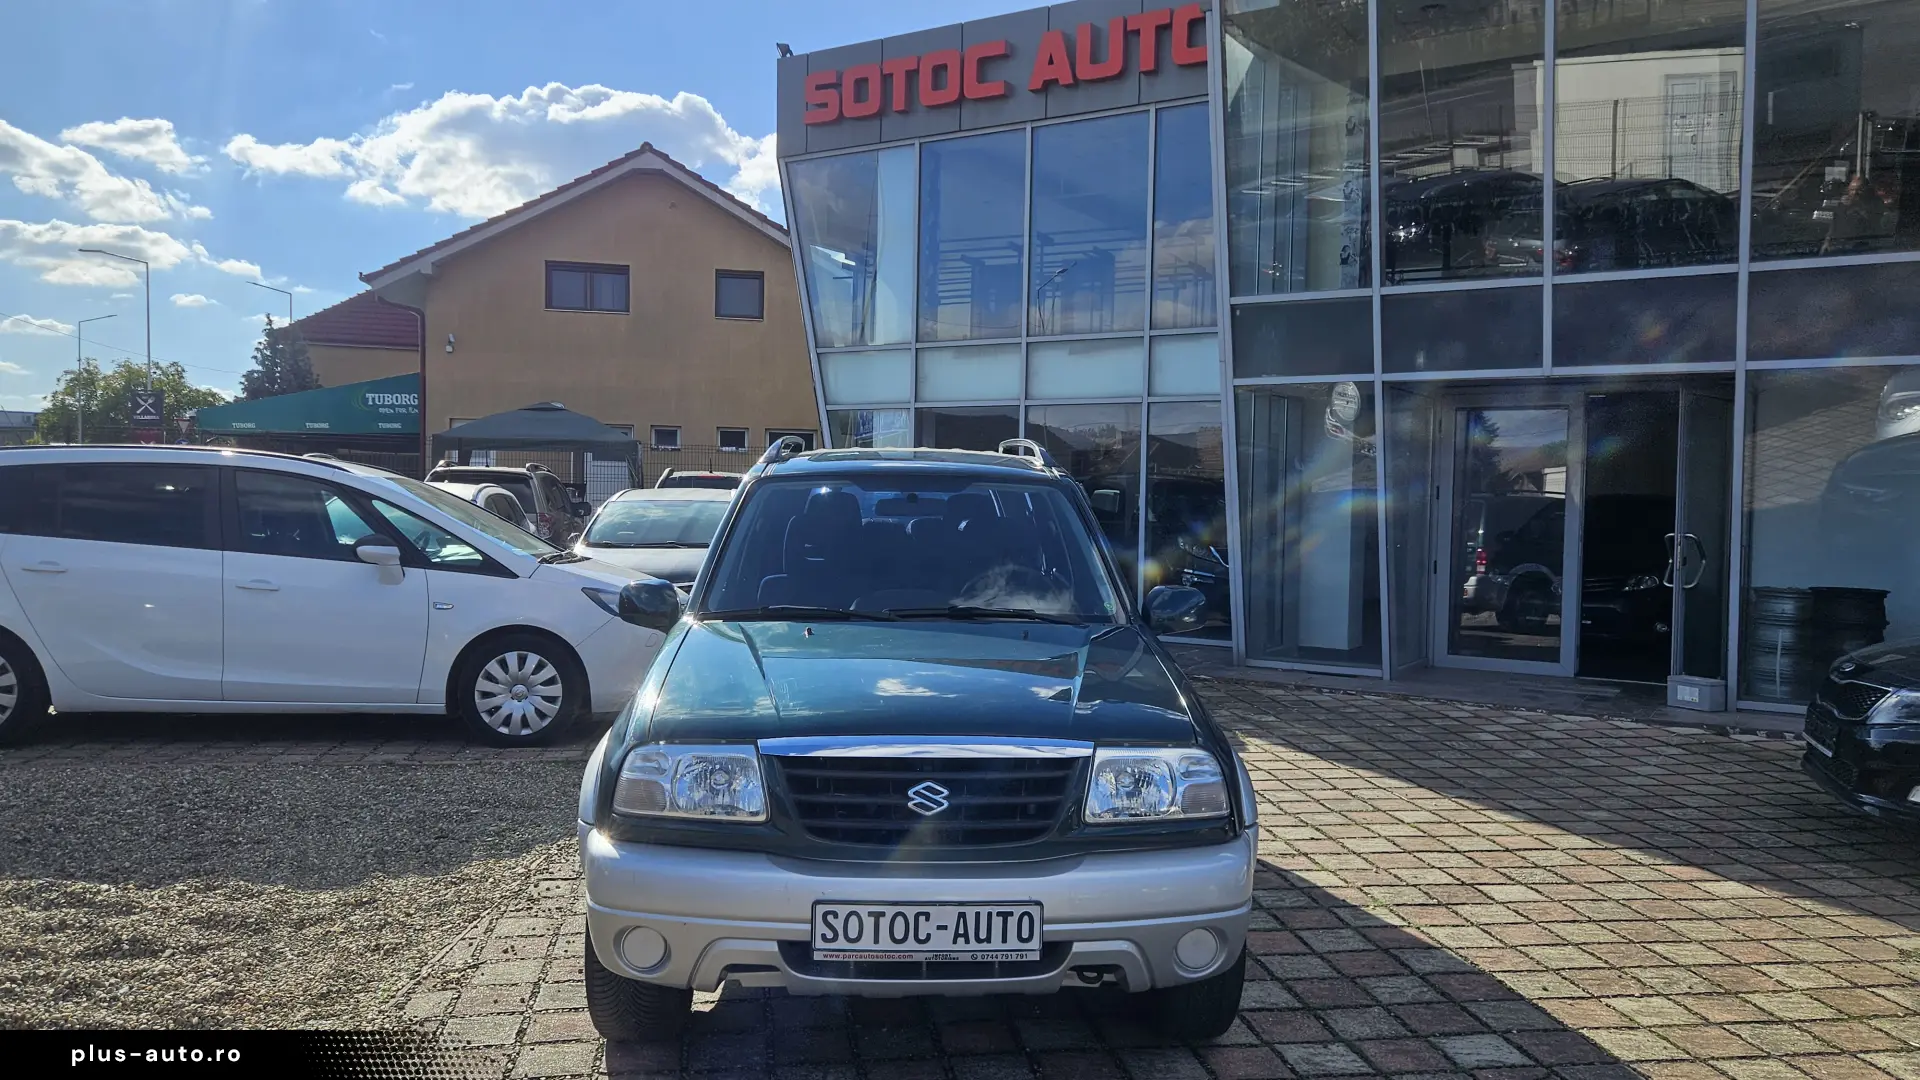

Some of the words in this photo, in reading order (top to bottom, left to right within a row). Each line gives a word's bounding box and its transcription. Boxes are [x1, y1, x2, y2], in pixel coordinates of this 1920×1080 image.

[804, 40, 1009, 126] SOTOC
[1028, 4, 1208, 93] AUTO
[365, 393, 419, 405] TUBORG
[820, 910, 1036, 945] SOTOC-AUTO
